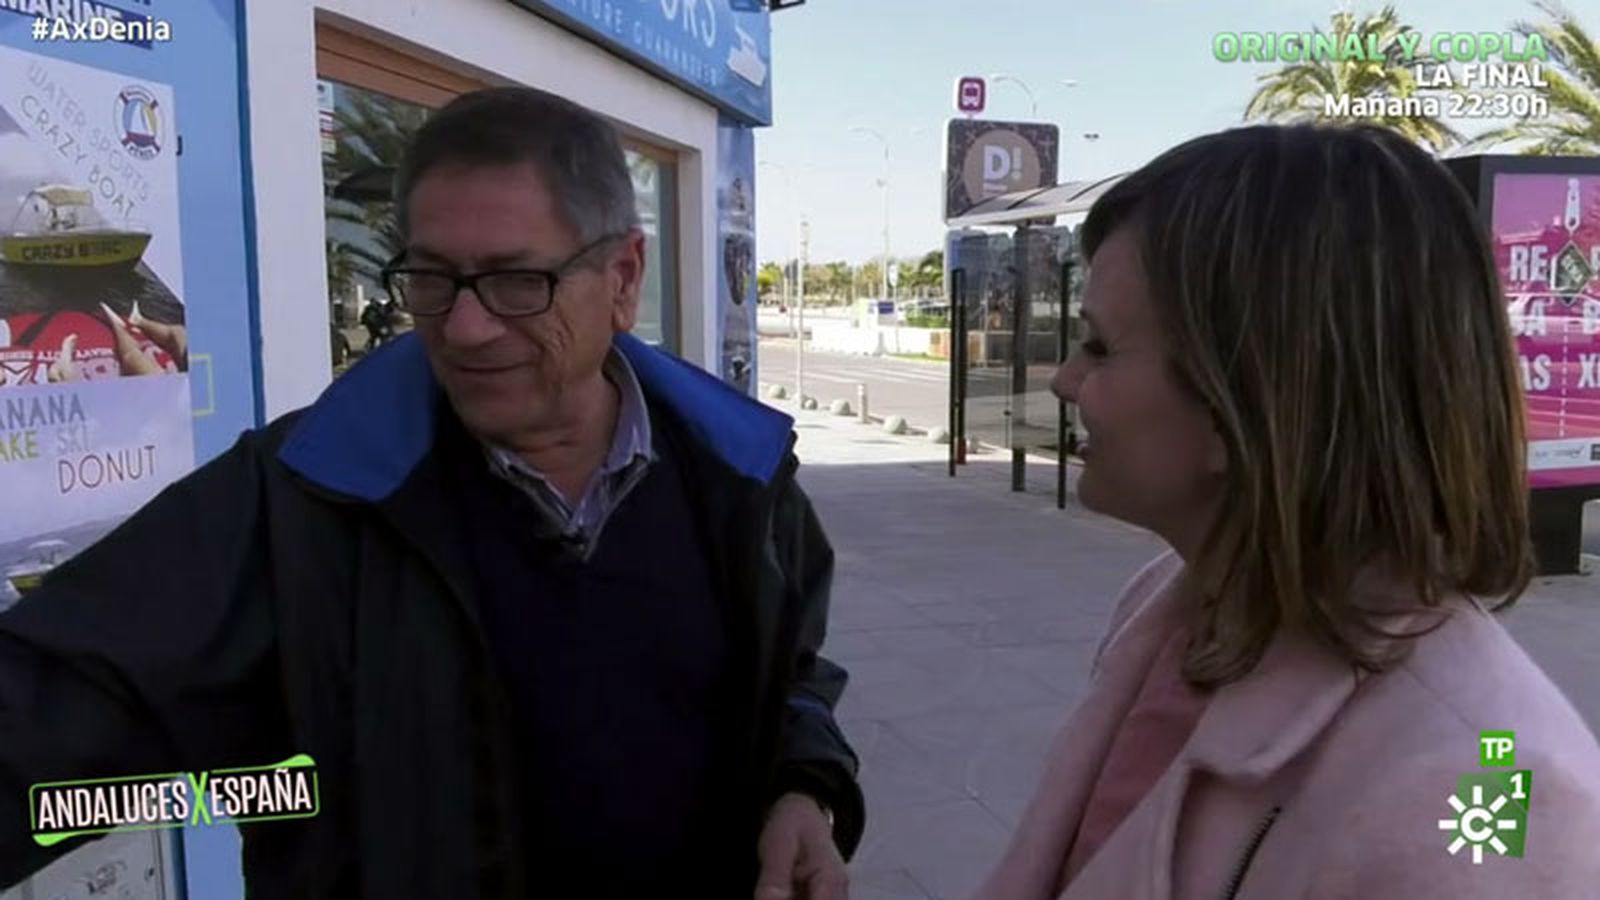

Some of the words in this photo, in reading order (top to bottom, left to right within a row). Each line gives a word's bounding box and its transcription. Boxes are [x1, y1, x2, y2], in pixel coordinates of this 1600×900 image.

[20, 95, 90, 165] CRAZY
[87, 164, 137, 218] BOAT
[58, 445, 156, 495] DONUT
